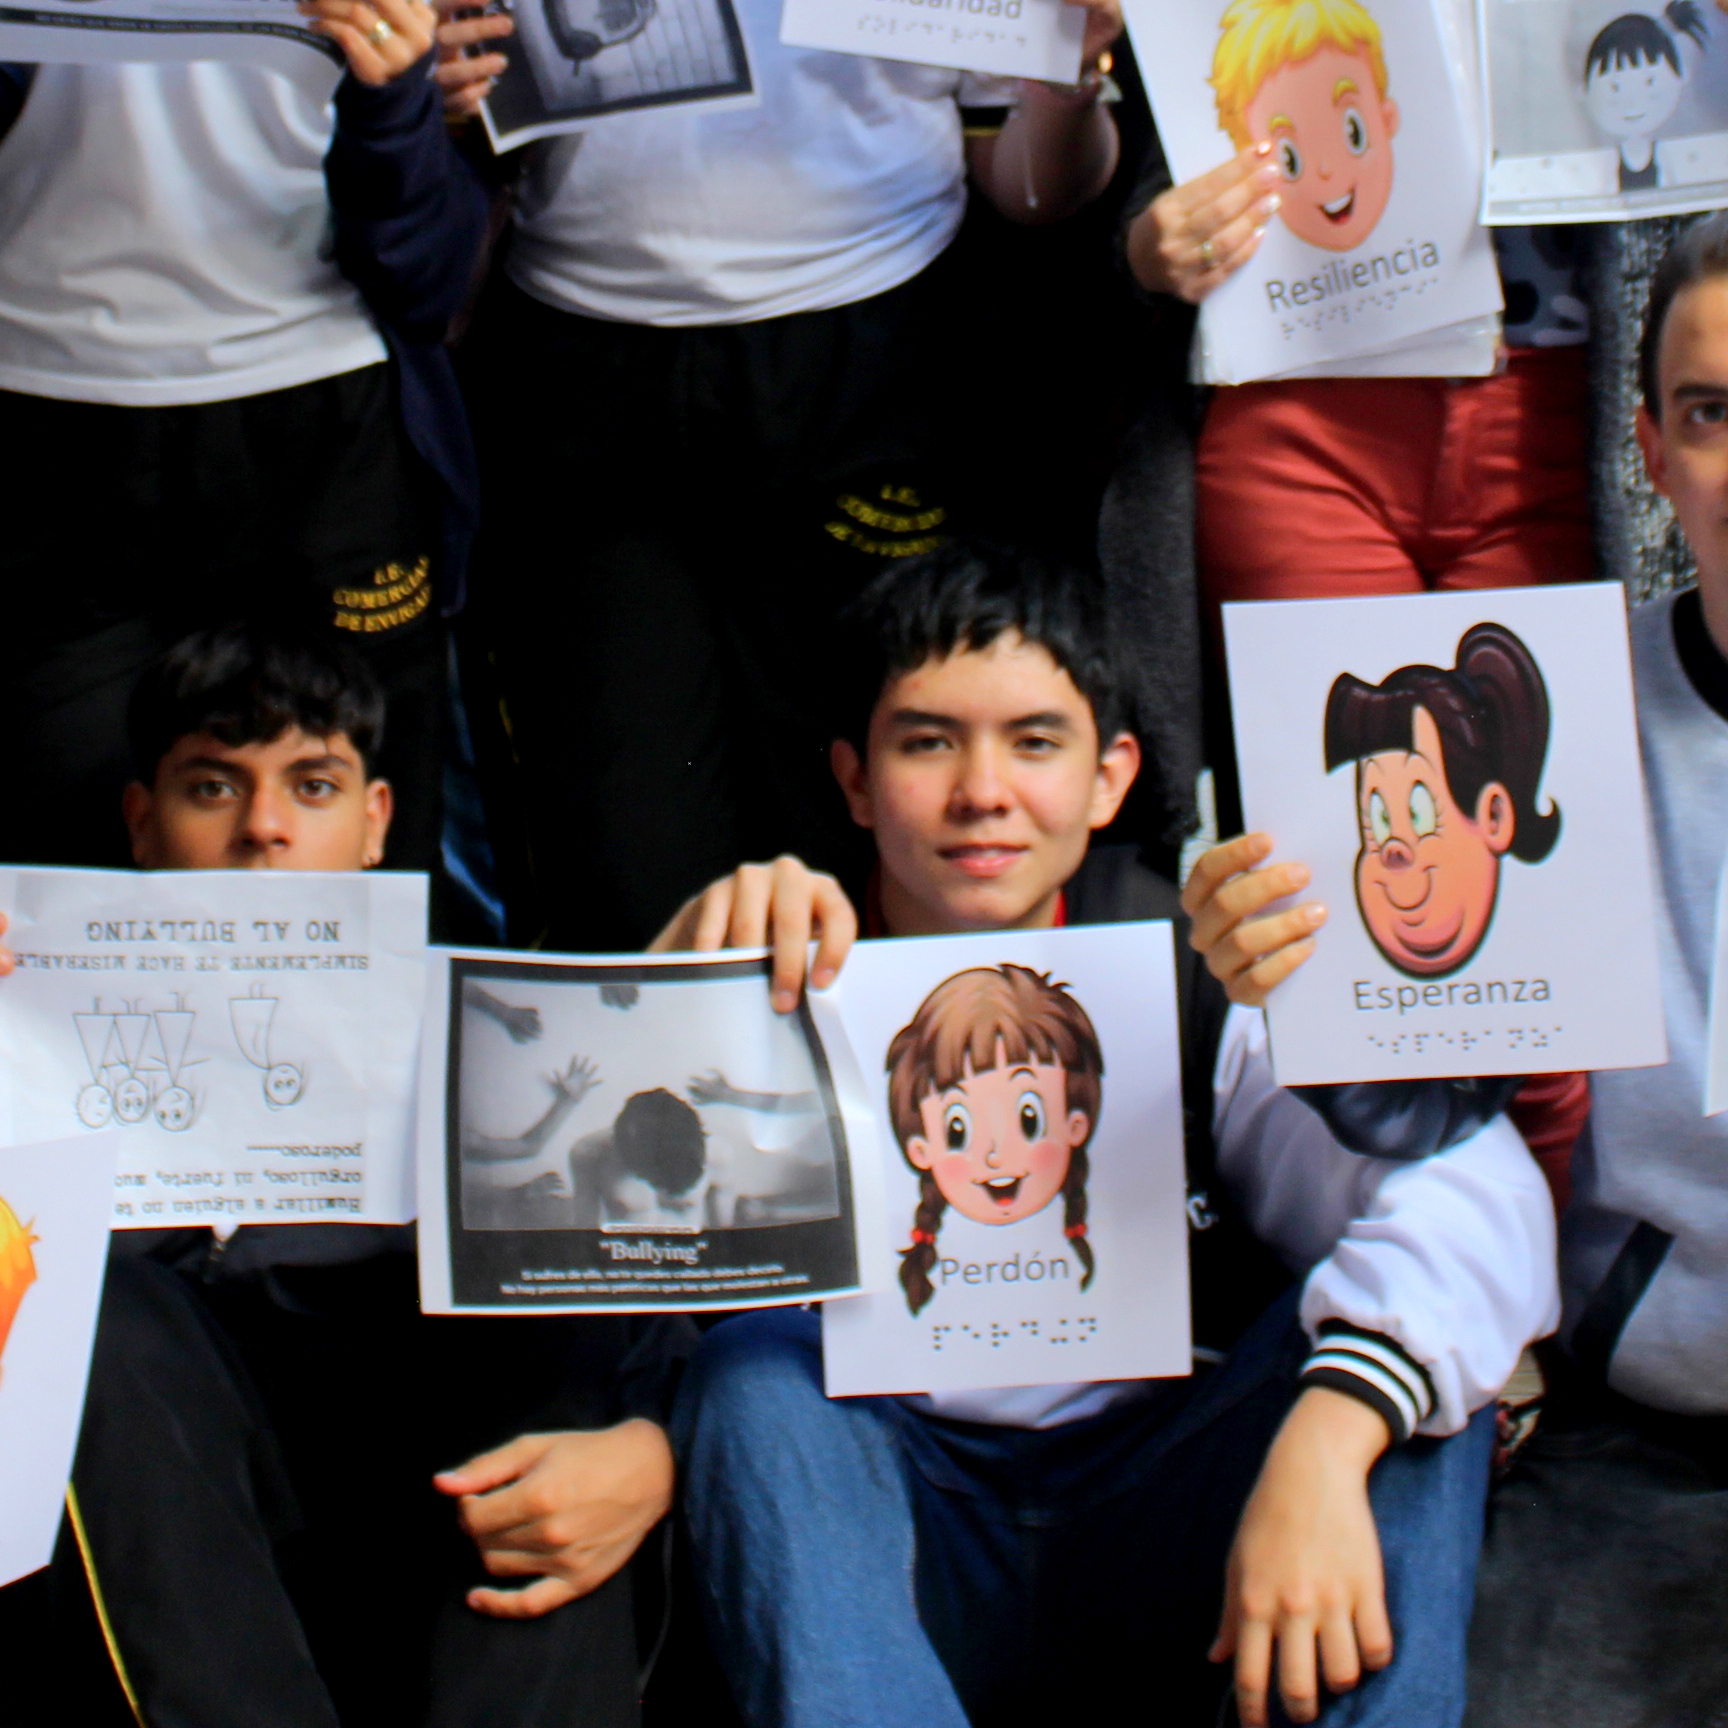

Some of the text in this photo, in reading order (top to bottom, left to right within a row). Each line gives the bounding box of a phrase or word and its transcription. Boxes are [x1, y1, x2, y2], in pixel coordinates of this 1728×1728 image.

[1264, 236, 1441, 313] Resiliencia
[334, 610, 362, 632] DE
[86, 920, 342, 943] NO AL BULLYING
[136, 954, 186, 971] HACE
[194, 954, 221, 971] TE
[230, 954, 369, 971] SIMPLEMENTE
[1352, 977, 1552, 1016] Esperanza
[156, 1169, 225, 1188] fuerte,
[235, 1171, 254, 1187] ni
[141, 1199, 164, 1214] no
[172, 1194, 246, 1215] alguien
[254, 1196, 265, 1211] a
[274, 1196, 362, 1214] Humillar
[599, 1238, 709, 1266] "Bullying"
[940, 1250, 1070, 1286] Perdón
